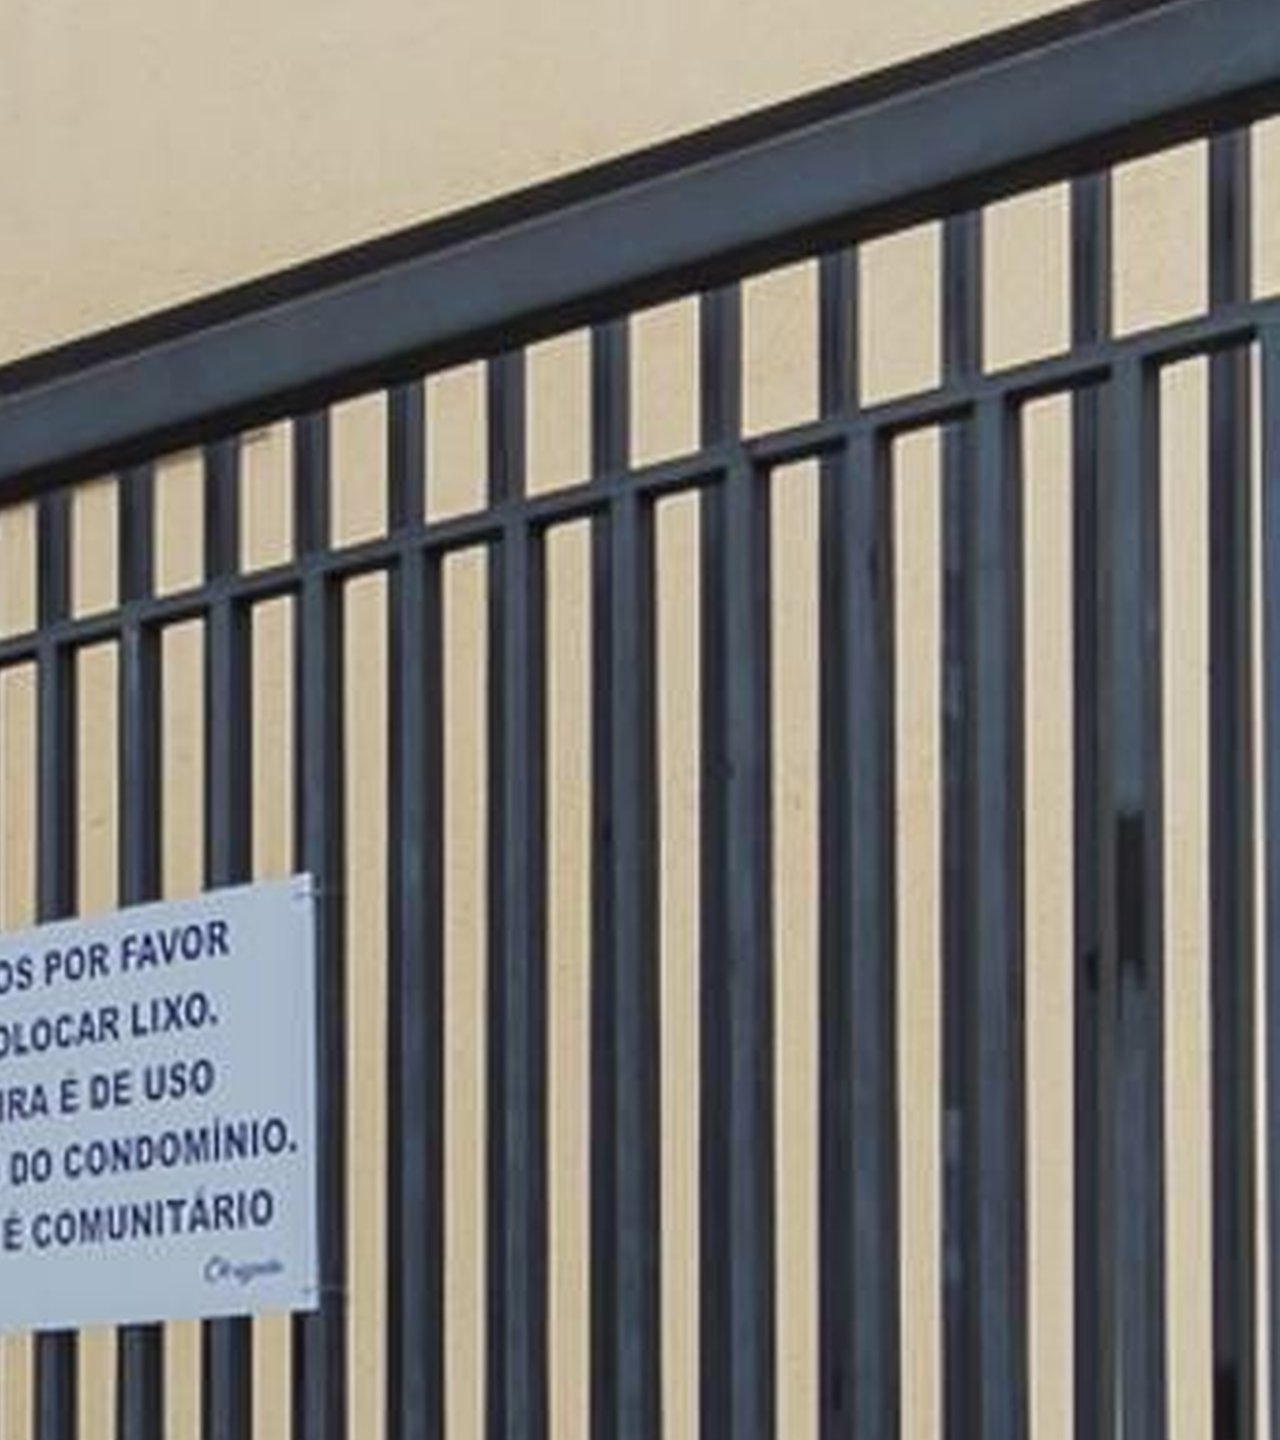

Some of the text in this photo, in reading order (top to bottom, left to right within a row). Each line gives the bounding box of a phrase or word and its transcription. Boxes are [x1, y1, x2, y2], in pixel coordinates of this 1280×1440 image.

[44, 942, 110, 987] POR
[120, 920, 230, 973] FAVOR
[131, 991, 218, 1036] LIXO.
[90, 1070, 131, 1109] DE
[145, 1059, 215, 1101] USO
[11, 1148, 52, 1187] DO
[64, 1117, 298, 1179] CONDOMÍNIO.
[31, 1188, 274, 1249] COMUNITÁRIO
